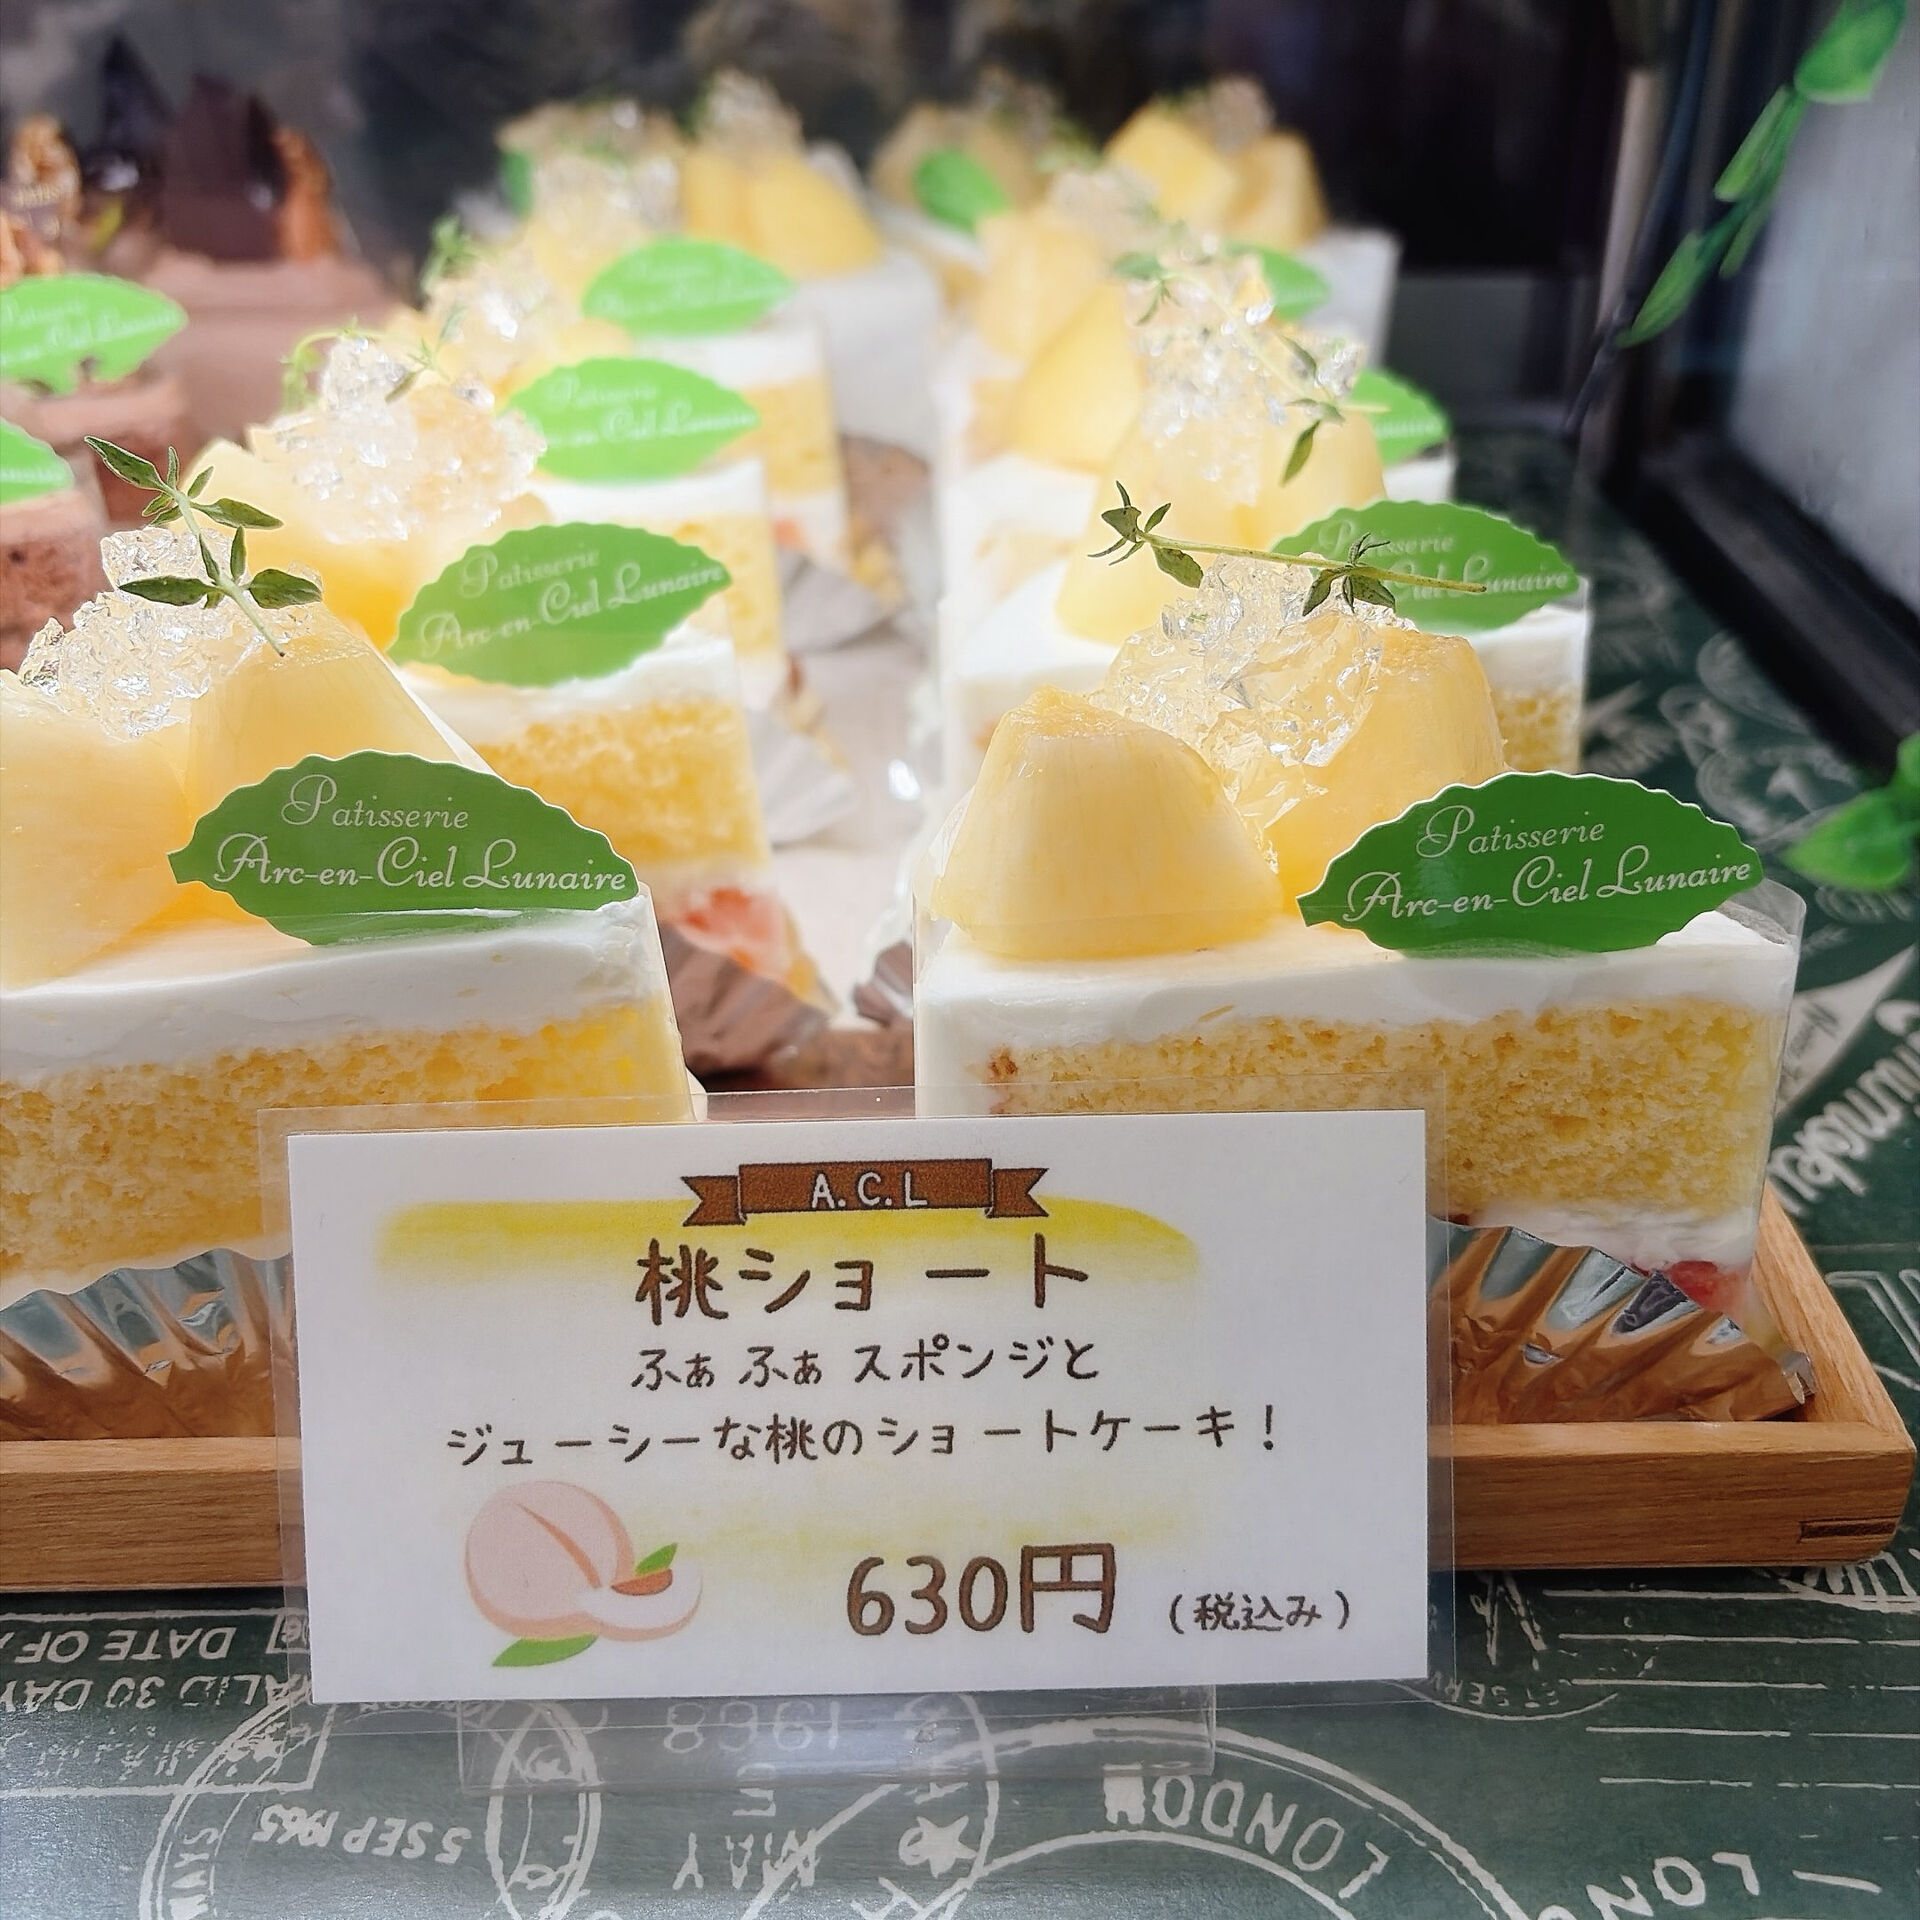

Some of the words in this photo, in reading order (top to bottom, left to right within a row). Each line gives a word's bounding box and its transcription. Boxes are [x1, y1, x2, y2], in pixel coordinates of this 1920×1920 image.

[459, 545, 599, 599] Patisserie
[607, 562, 725, 610] Lunaire
[281, 774, 469, 829] Patisserie
[1416, 805, 1605, 859] Patisserie
[213, 833, 455, 889] Arc-en-Ciel
[463, 838, 627, 891] Lunaire
[1342, 855, 1592, 922] Arc-en-Ciel
[1596, 845, 1751, 898] Lunaire
[811, 1171, 928, 1210] A.C.L
[634, 1234, 1090, 1326] 桃ショート
[846, 1542, 1117, 1637] 630円
[14, 1630, 90, 1665] OF
[98, 1626, 237, 1662] DATE
[1537, 1851, 1761, 1920] LON
